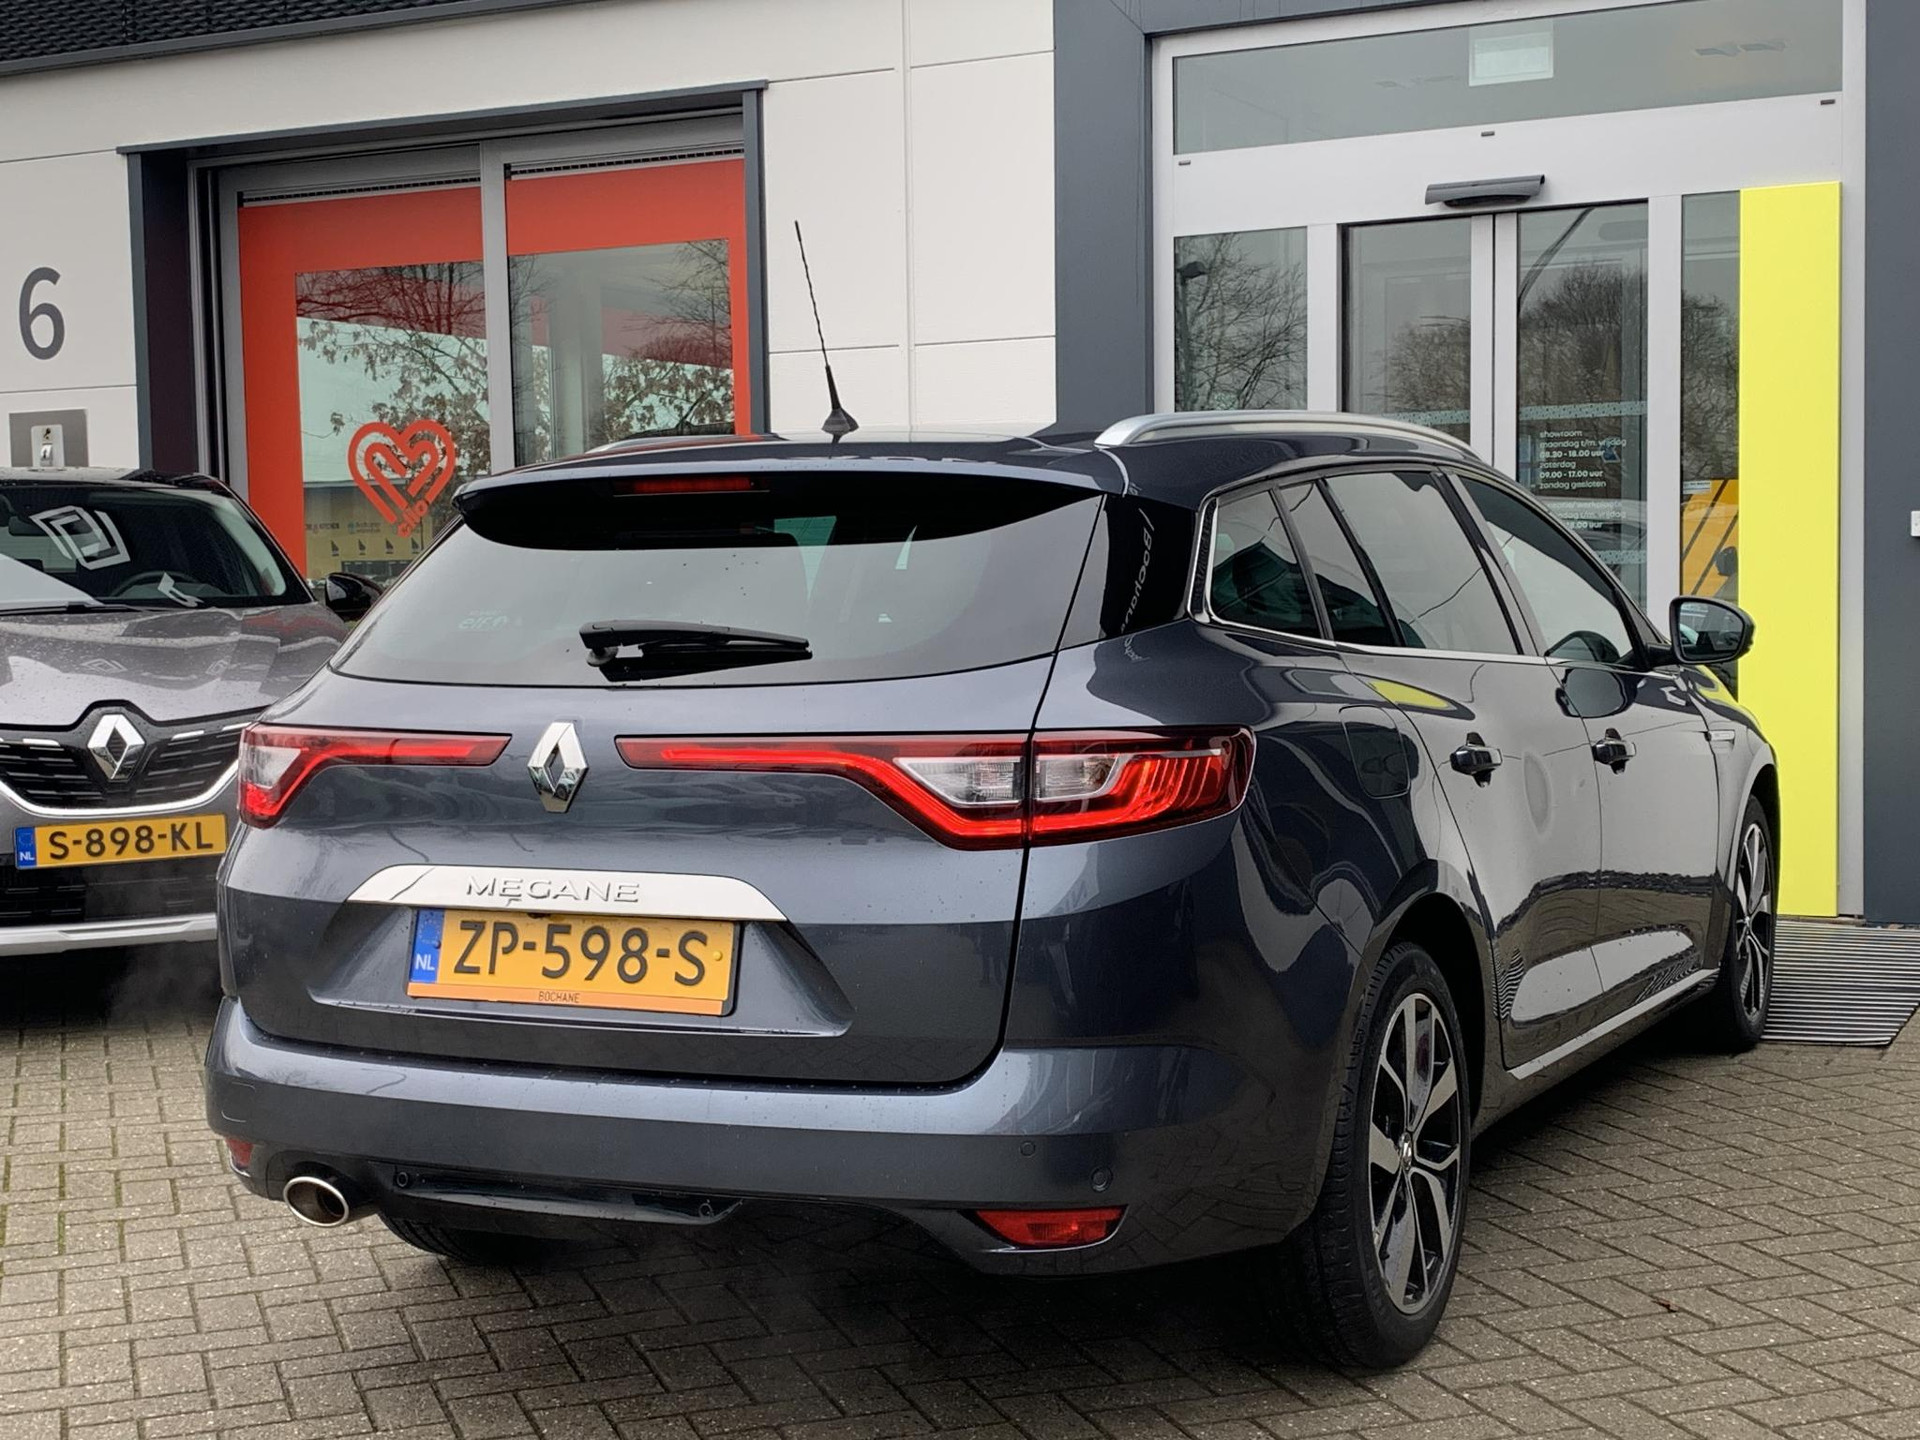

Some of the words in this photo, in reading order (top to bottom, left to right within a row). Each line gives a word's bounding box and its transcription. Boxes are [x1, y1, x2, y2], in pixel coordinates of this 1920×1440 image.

[19, 266, 65, 360] 6
[1540, 430, 1583, 438] showroom
[1540, 440, 1579, 449] maandag
[1540, 460, 1577, 469] zaterdag
[1568, 470, 1588, 478] 17.00
[1540, 480, 1570, 490] zondag
[19, 851, 36, 862] NL
[48, 821, 214, 861] S-898-KL
[415, 953, 436, 971] NL
[453, 919, 709, 987] ZP-598-S
[538, 990, 581, 1004] BOCHANE
